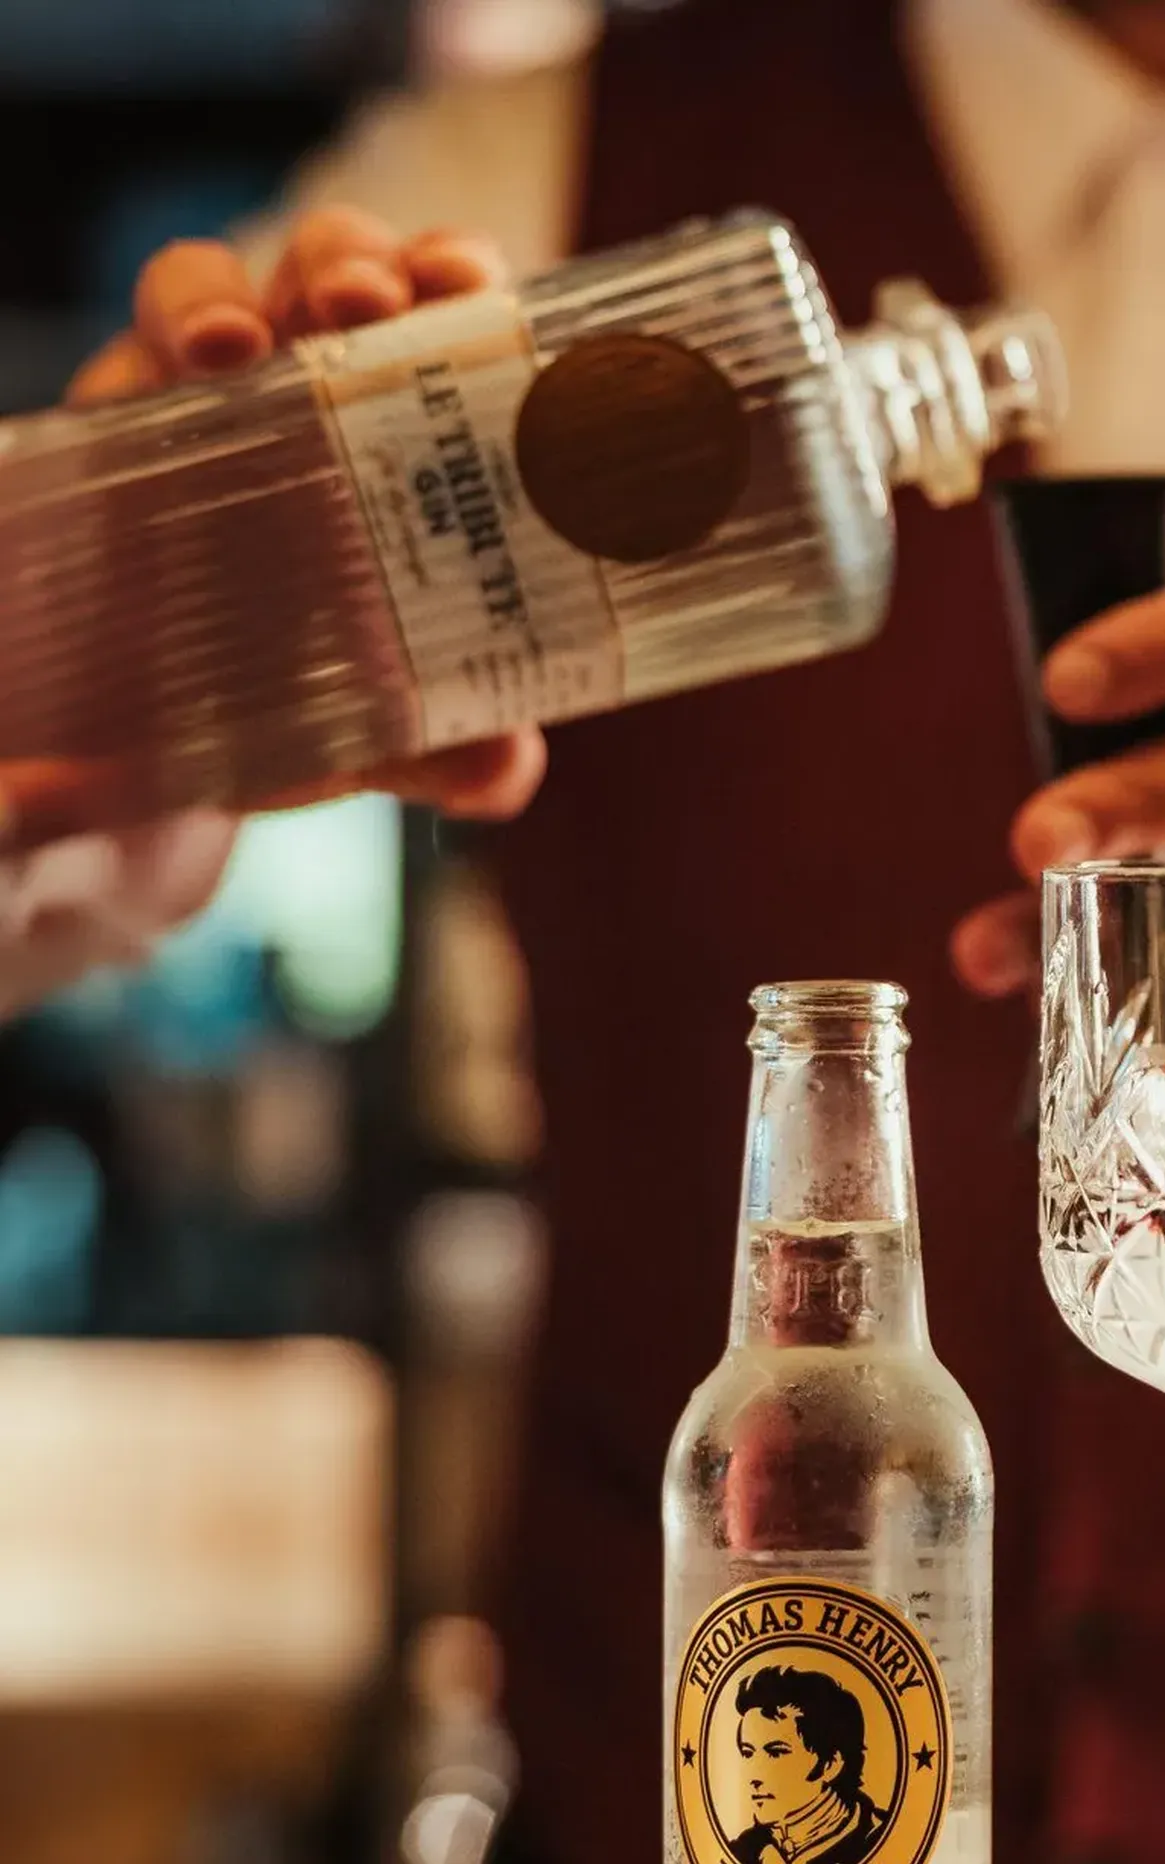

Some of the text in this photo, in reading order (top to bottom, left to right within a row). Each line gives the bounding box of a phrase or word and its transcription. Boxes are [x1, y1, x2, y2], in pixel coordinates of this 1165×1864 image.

[415, 361, 463, 418] LE
[413, 467, 454, 538] GIN
[689, 1599, 925, 1697] THOMAS HENRY
